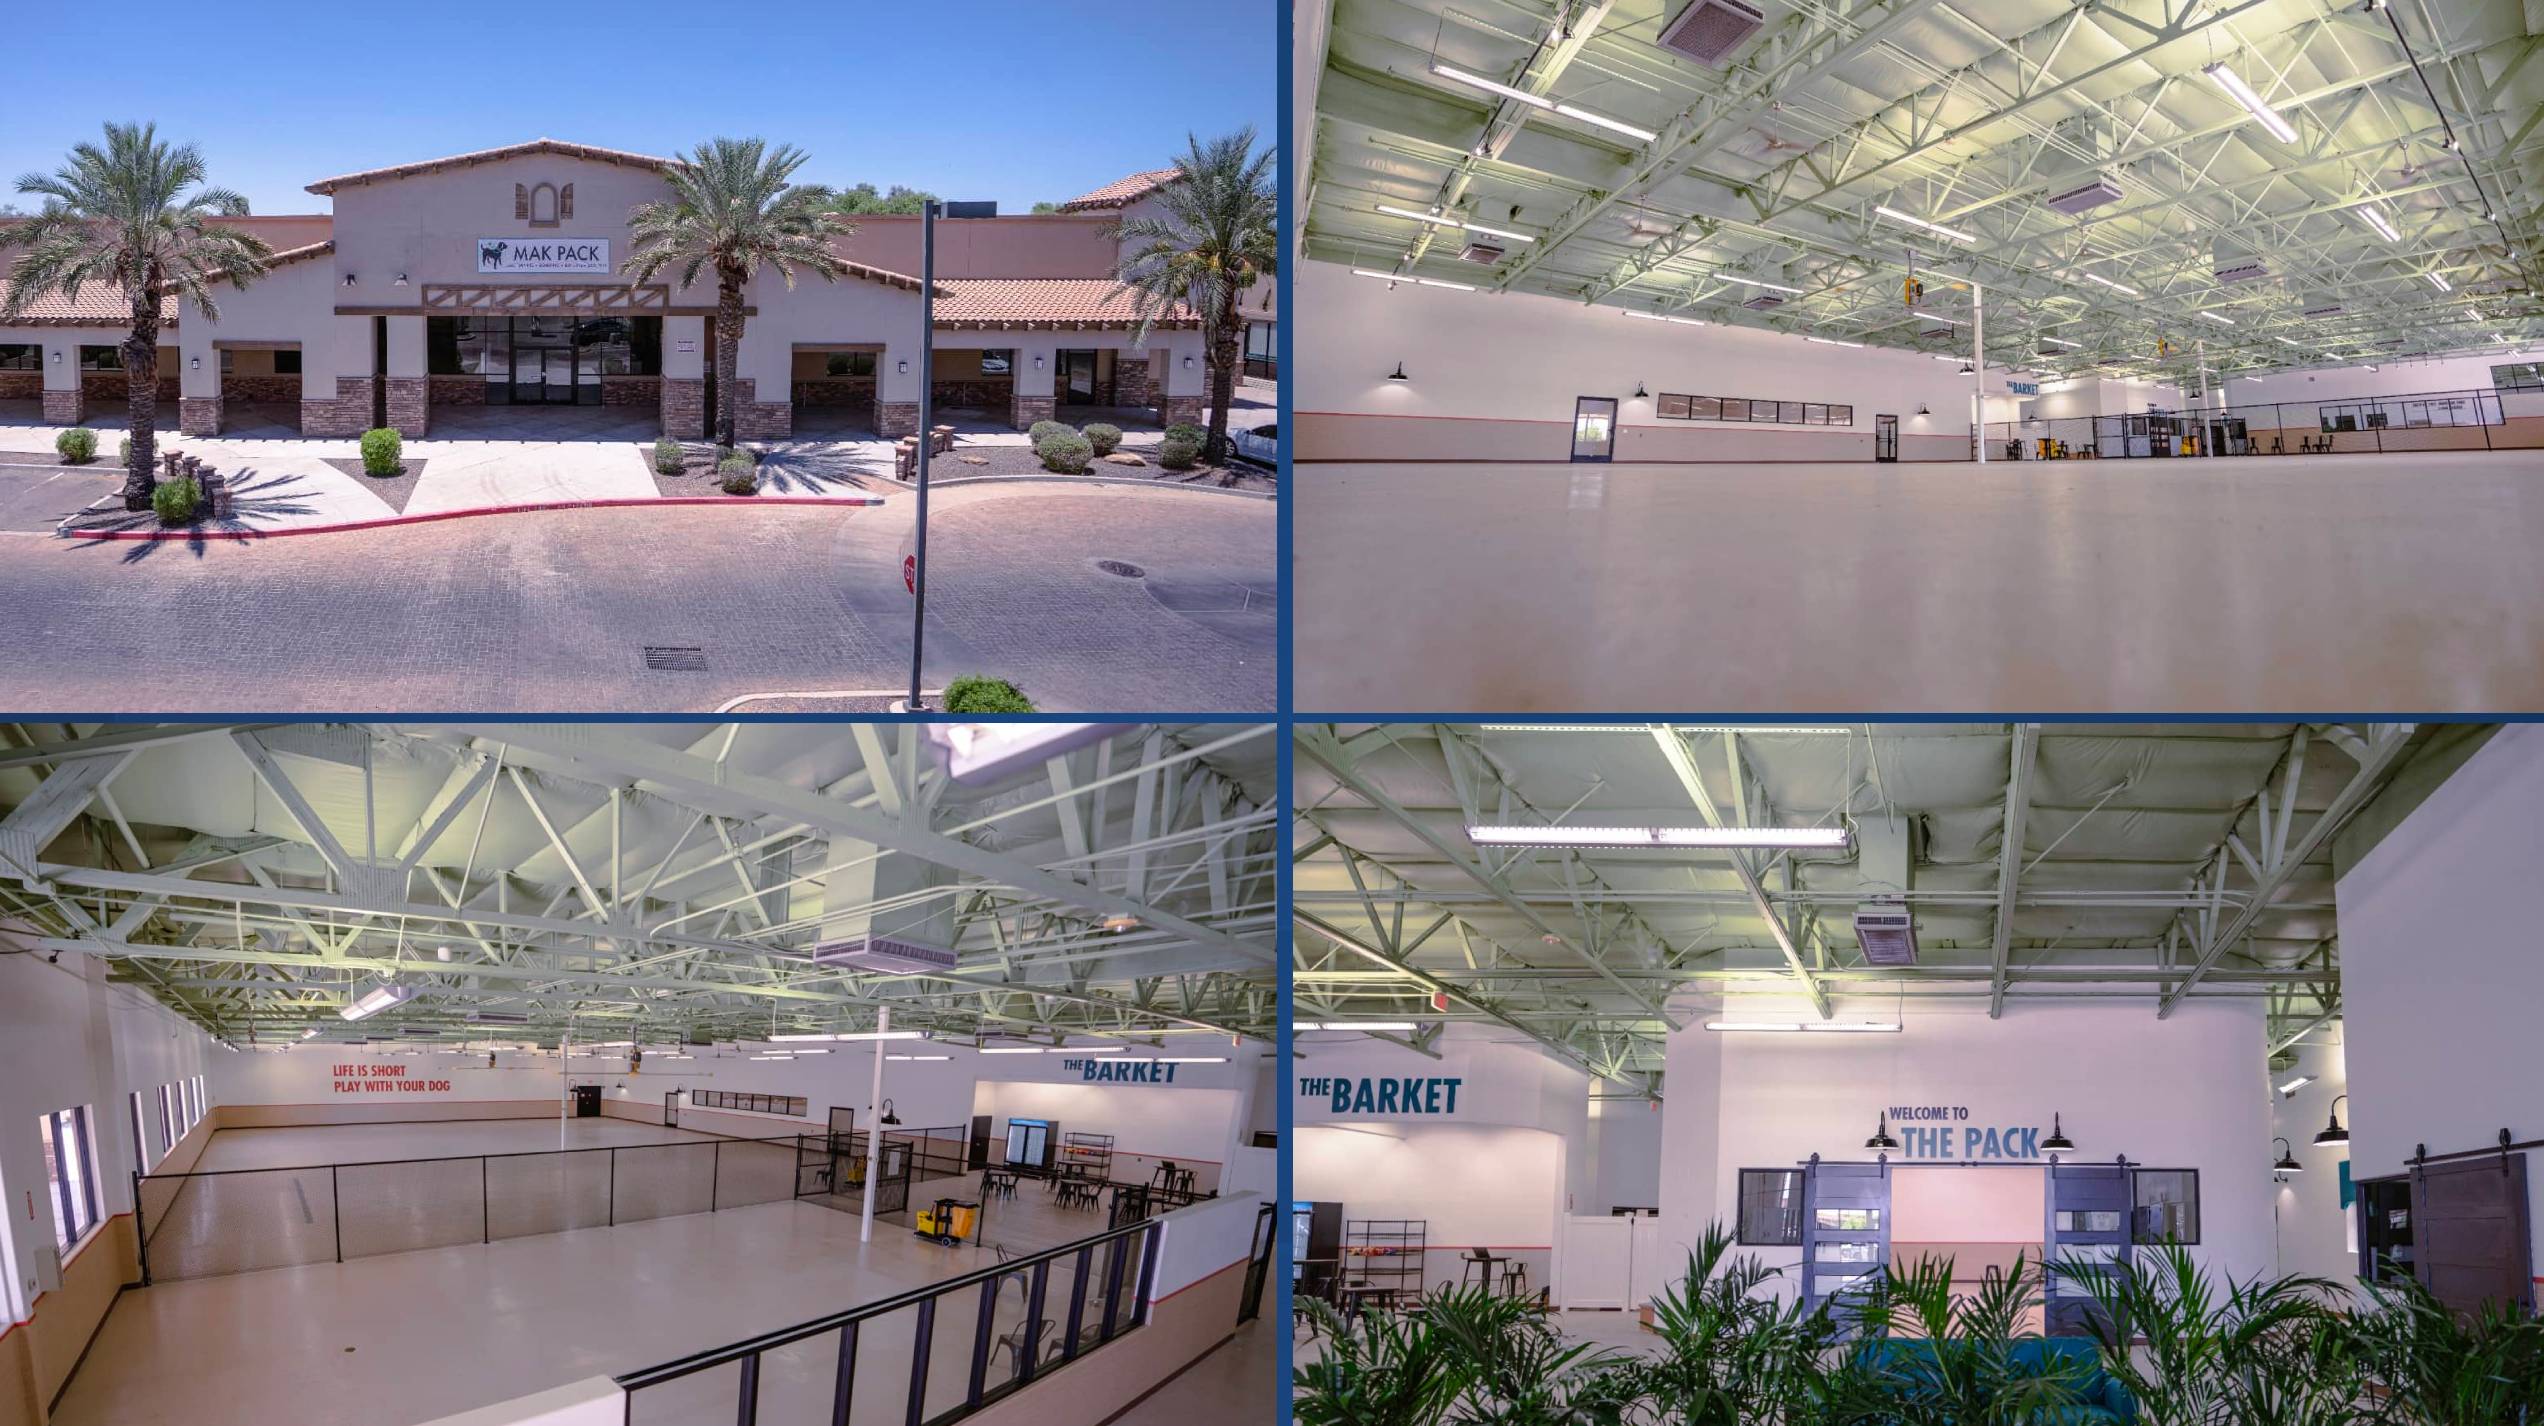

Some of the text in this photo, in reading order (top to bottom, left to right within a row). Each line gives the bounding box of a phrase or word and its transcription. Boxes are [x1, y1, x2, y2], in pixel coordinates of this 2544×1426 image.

[514, 245, 600, 261] MAK PACK
[2013, 382, 2039, 396] BARKET
[333, 1065, 406, 1077] LIFE IS SHORT
[1063, 1059, 1180, 1083] THE BARKET
[334, 1080, 451, 1093] PLAY WITH YOUR DOG
[1299, 1078, 1462, 1114] THE BARKET
[1889, 1106, 1969, 1120] WELCOME TO
[1901, 1127, 2039, 1158] THE PACK
